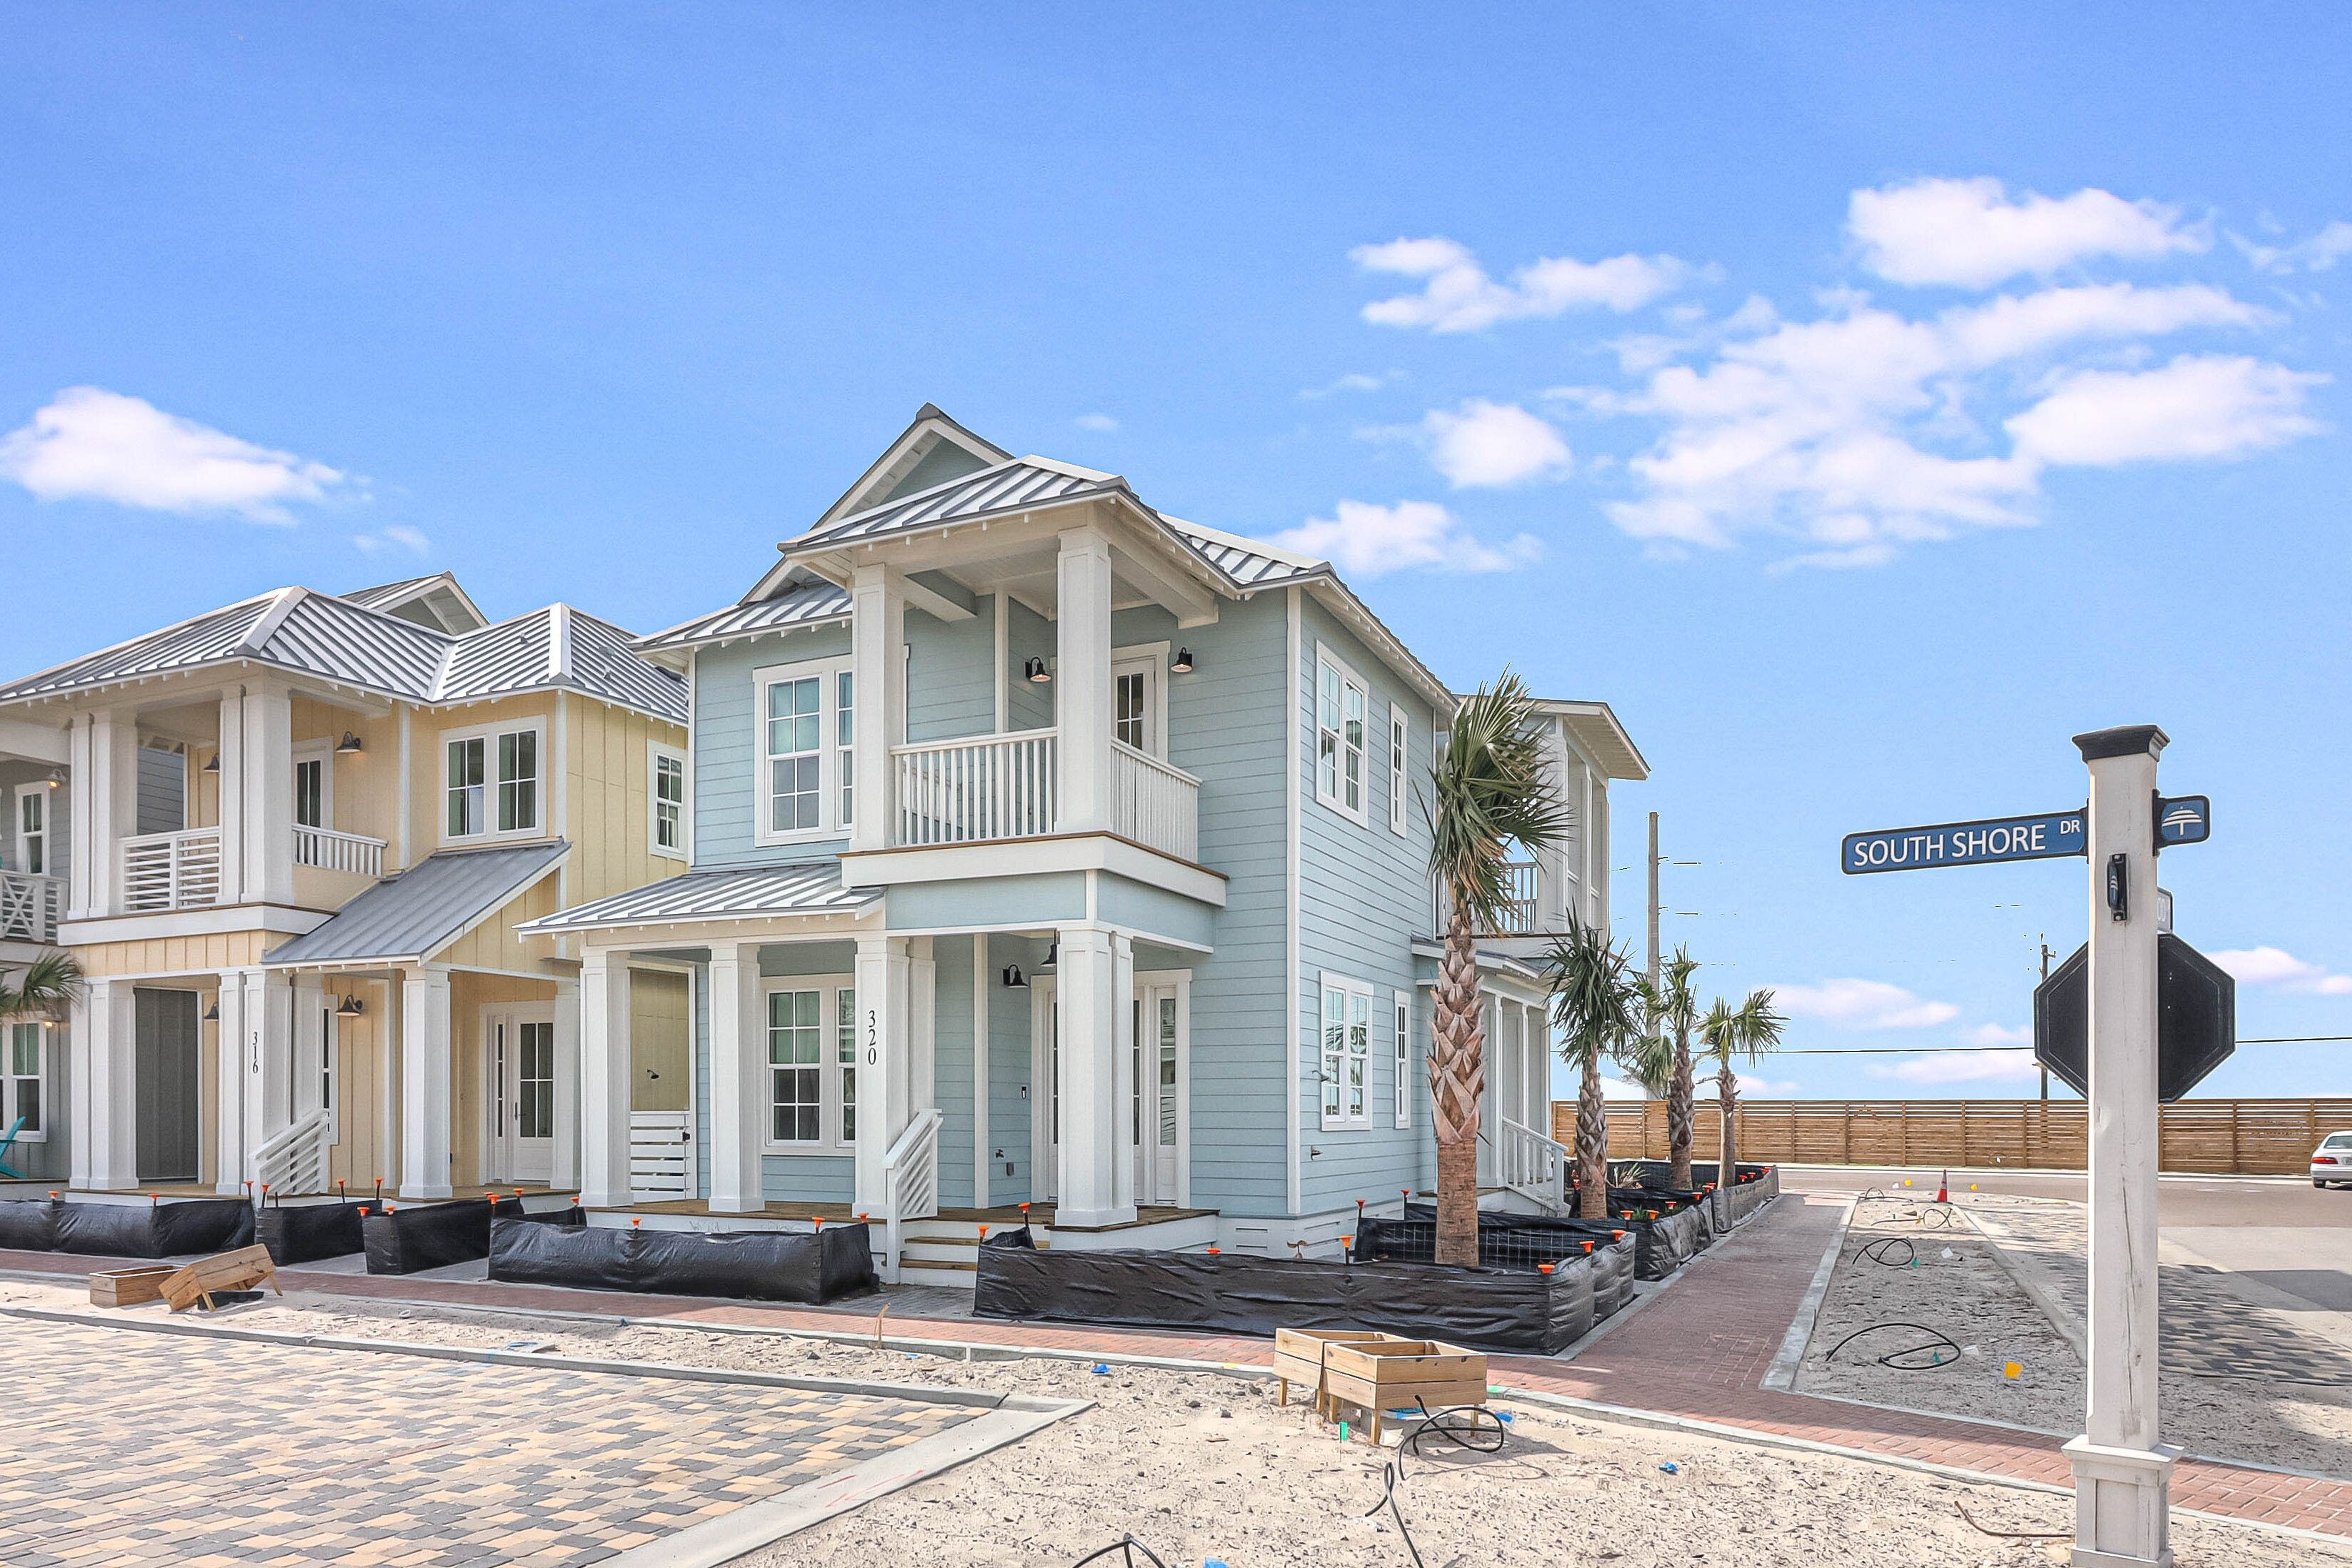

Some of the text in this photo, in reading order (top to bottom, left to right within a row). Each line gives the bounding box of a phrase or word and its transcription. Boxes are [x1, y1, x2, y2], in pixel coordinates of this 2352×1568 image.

[1853, 818, 2081, 867] SOUTH SHORE DR
[868, 1010, 876, 1065] 320
